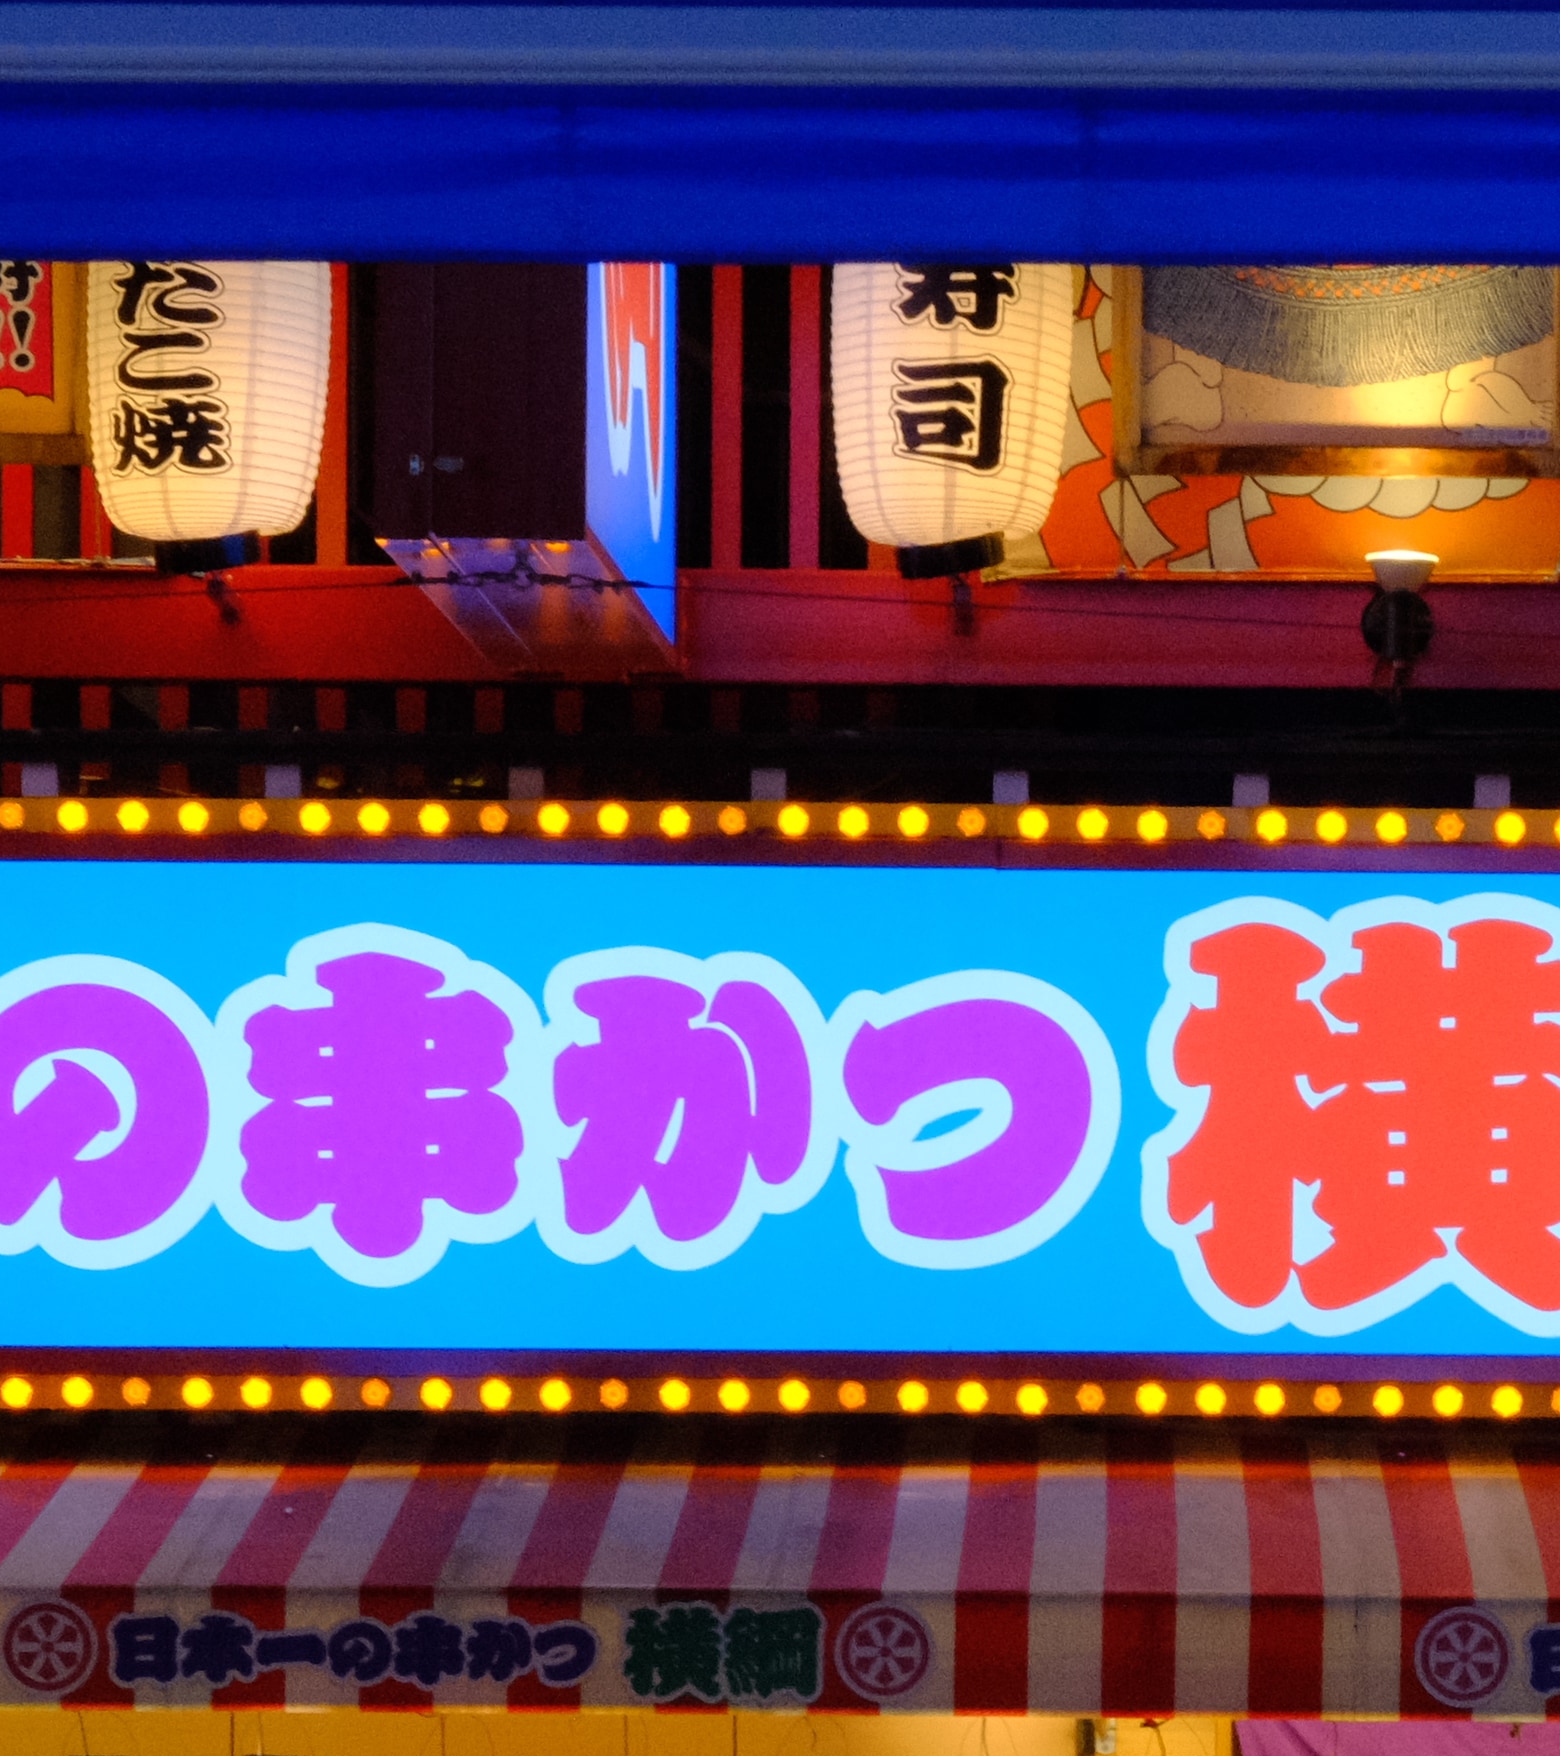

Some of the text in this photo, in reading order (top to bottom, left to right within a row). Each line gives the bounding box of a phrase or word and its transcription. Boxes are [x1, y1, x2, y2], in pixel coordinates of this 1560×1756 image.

[114, 260, 232, 475] たこ焼
[894, 264, 1019, 470] 寿司
[109, 1602, 826, 1702] 日本一の串かつ 横綱
